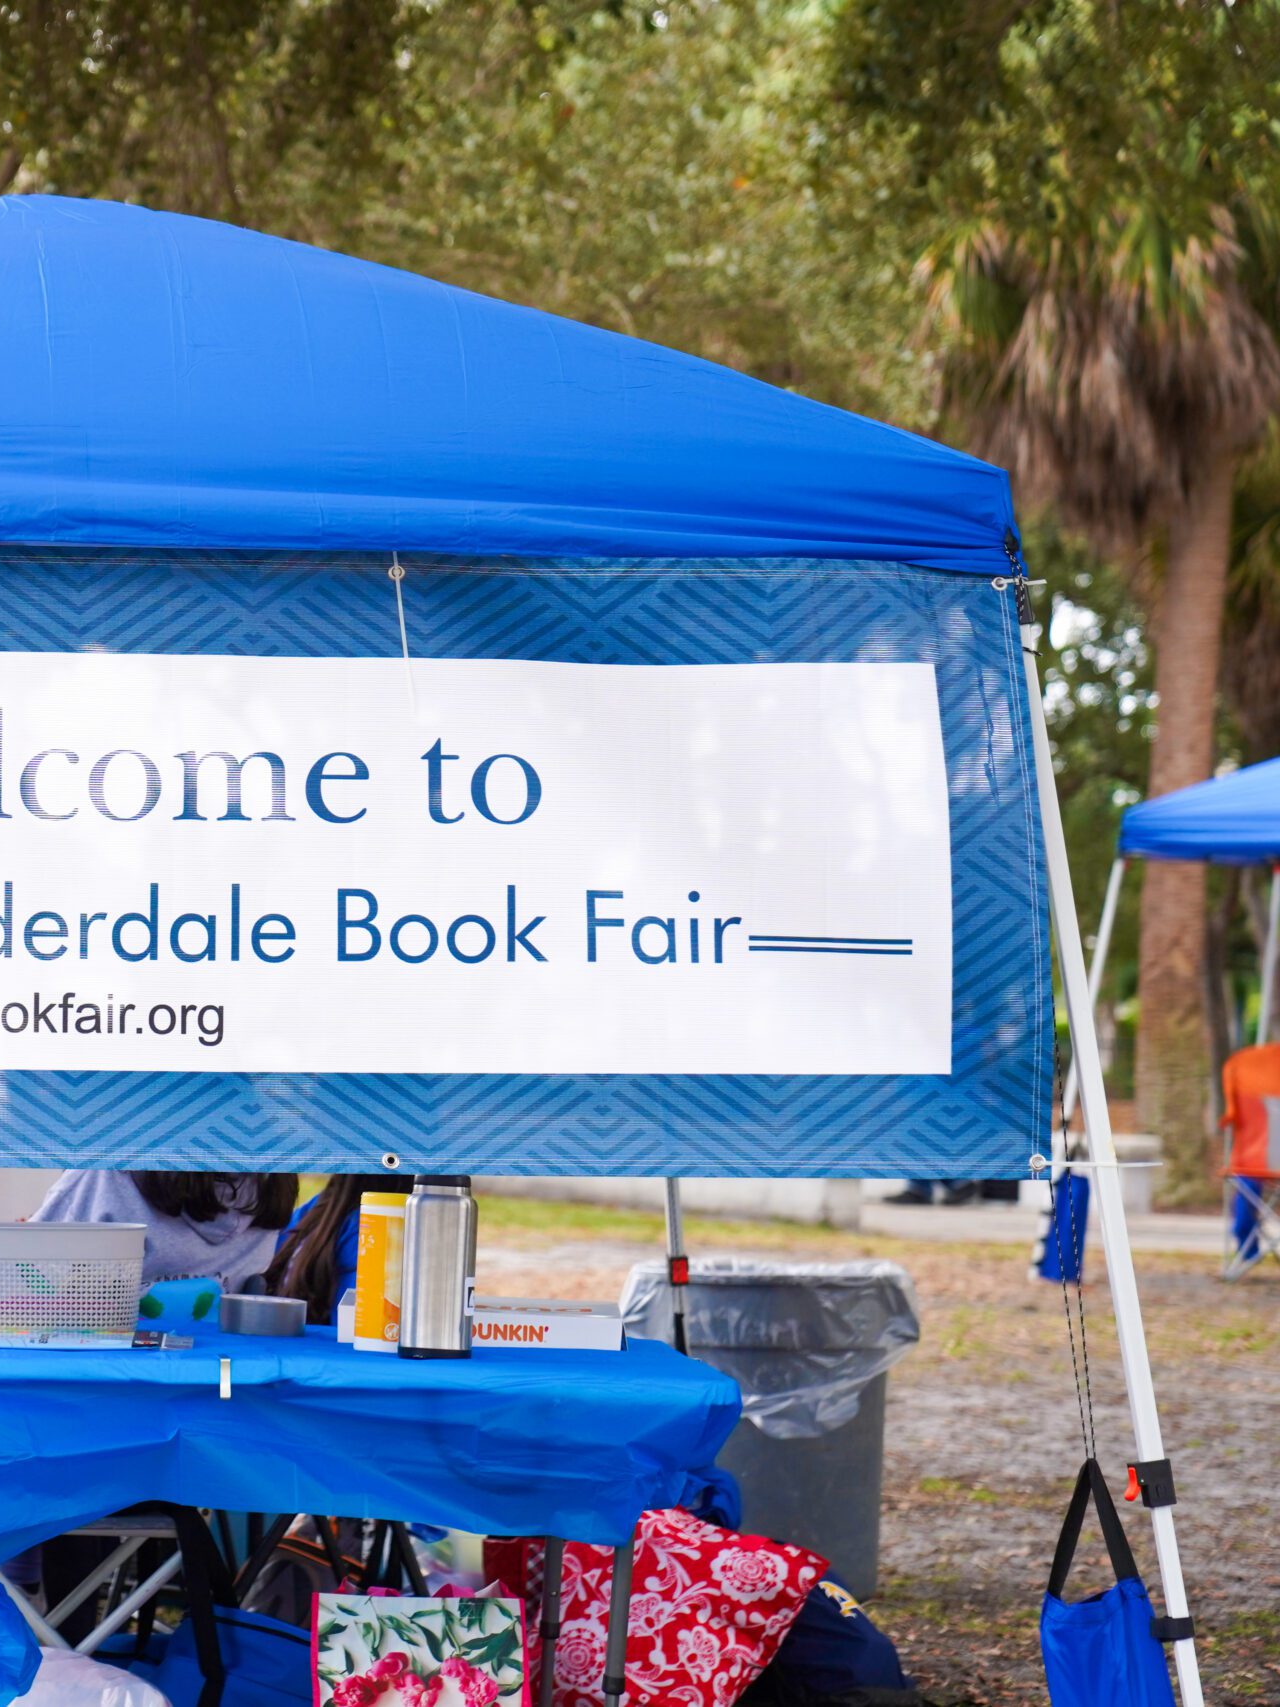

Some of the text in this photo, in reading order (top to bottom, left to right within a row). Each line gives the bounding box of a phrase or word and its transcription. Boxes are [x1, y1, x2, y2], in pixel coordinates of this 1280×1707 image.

[420, 737, 543, 825] to
[336, 885, 549, 963] Book
[586, 890, 743, 965] Fair
